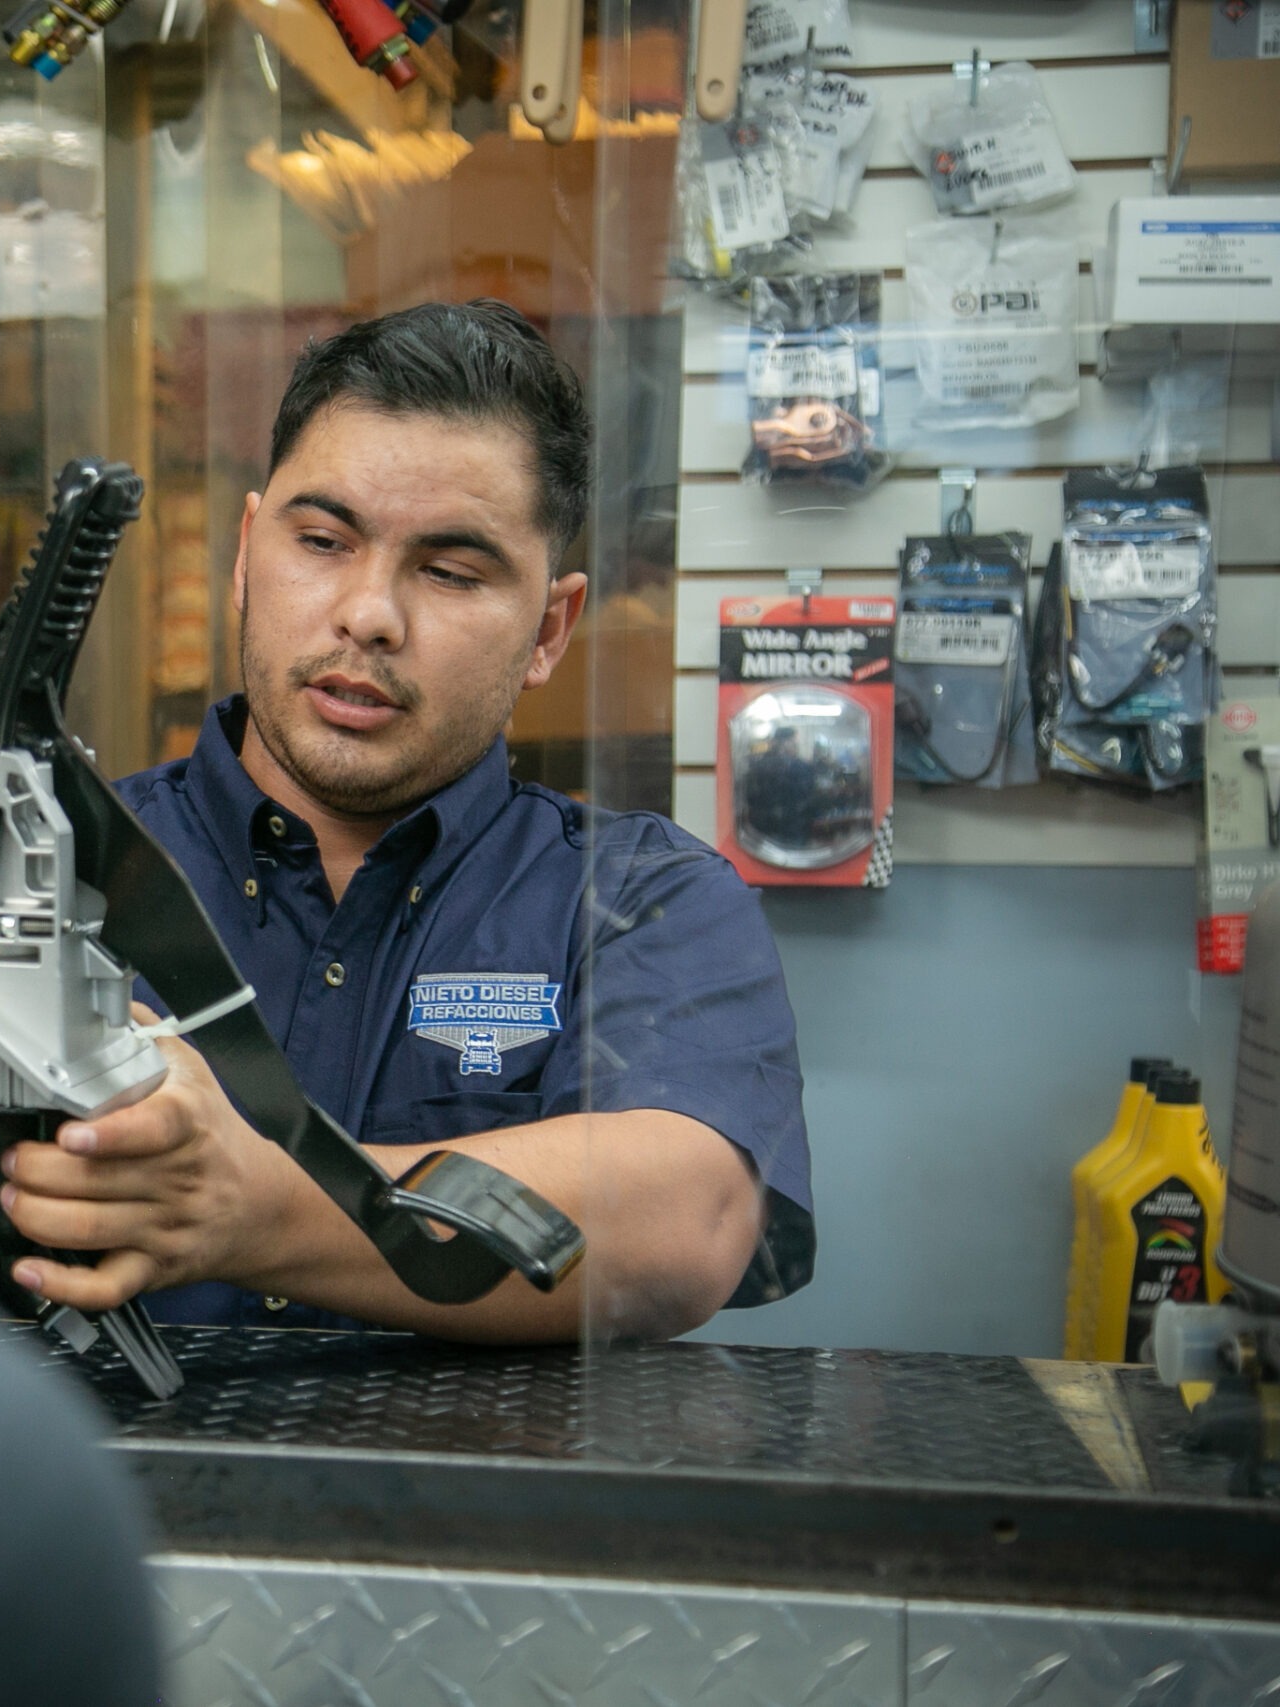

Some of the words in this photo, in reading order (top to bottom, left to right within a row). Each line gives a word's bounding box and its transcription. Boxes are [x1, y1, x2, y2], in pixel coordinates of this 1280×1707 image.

[741, 627, 800, 650] Wide
[803, 627, 869, 655] Angle
[740, 651, 854, 678] MIRROR
[1213, 863, 1258, 881] Dirko
[1215, 883, 1254, 902] Grey
[415, 986, 475, 1002] NIETO
[479, 986, 552, 1002] DIESEL
[422, 1005, 542, 1021] REFACCIONES
[1173, 1264, 1201, 1303] 3
